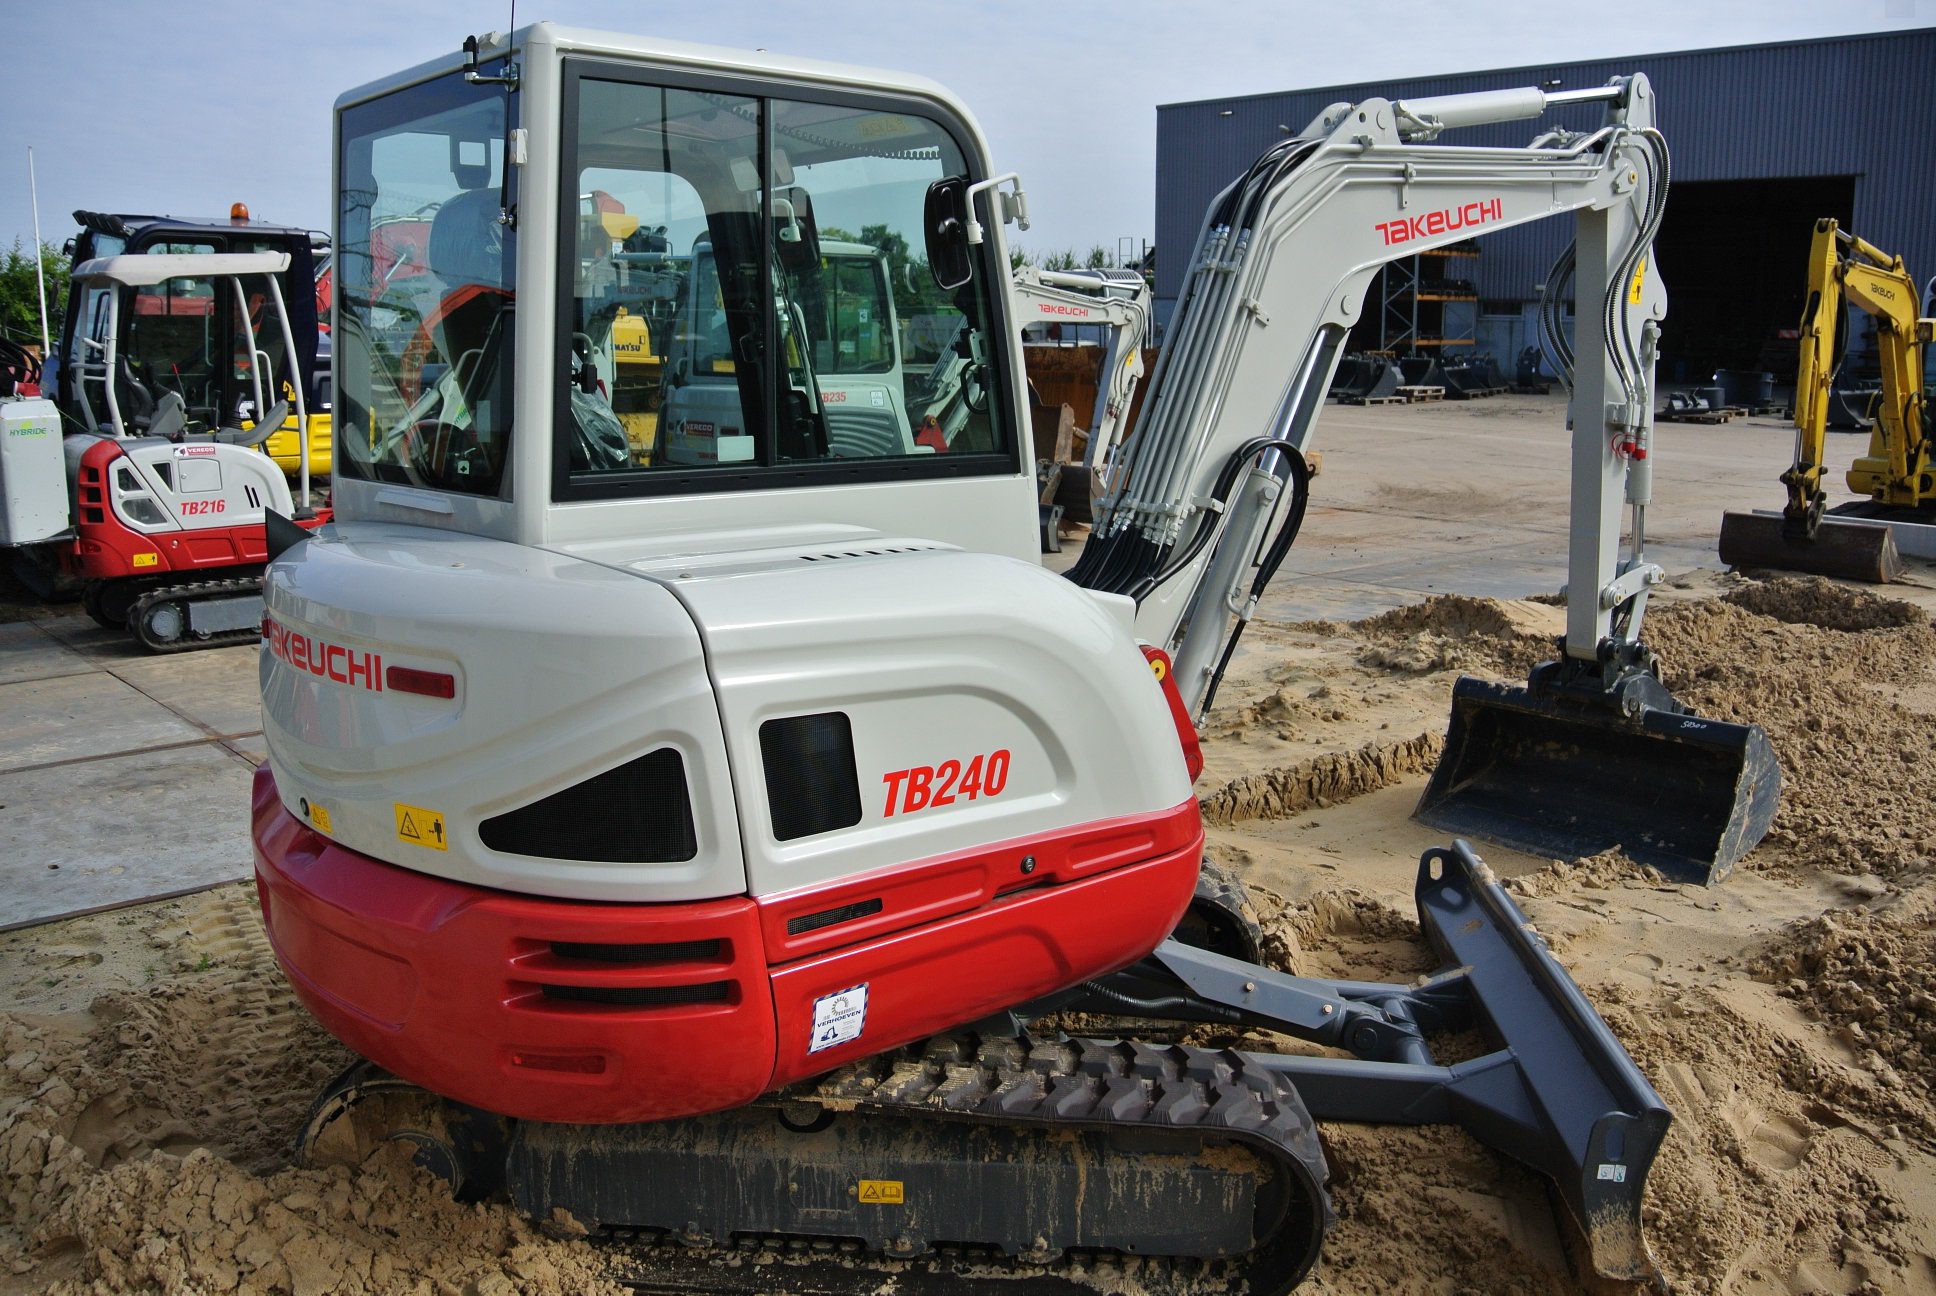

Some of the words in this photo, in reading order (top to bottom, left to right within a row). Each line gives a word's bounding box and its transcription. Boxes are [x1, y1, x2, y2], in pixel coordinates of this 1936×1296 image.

[1375, 198, 1502, 246] TAKEUCHI
[1038, 303, 1089, 317] TAKEUCHI
[9, 427, 47, 436] HYBRIDE
[180, 499, 226, 516] TB216
[882, 749, 1011, 818] TB240
[816, 1009, 862, 1028] VERHOEVEN
